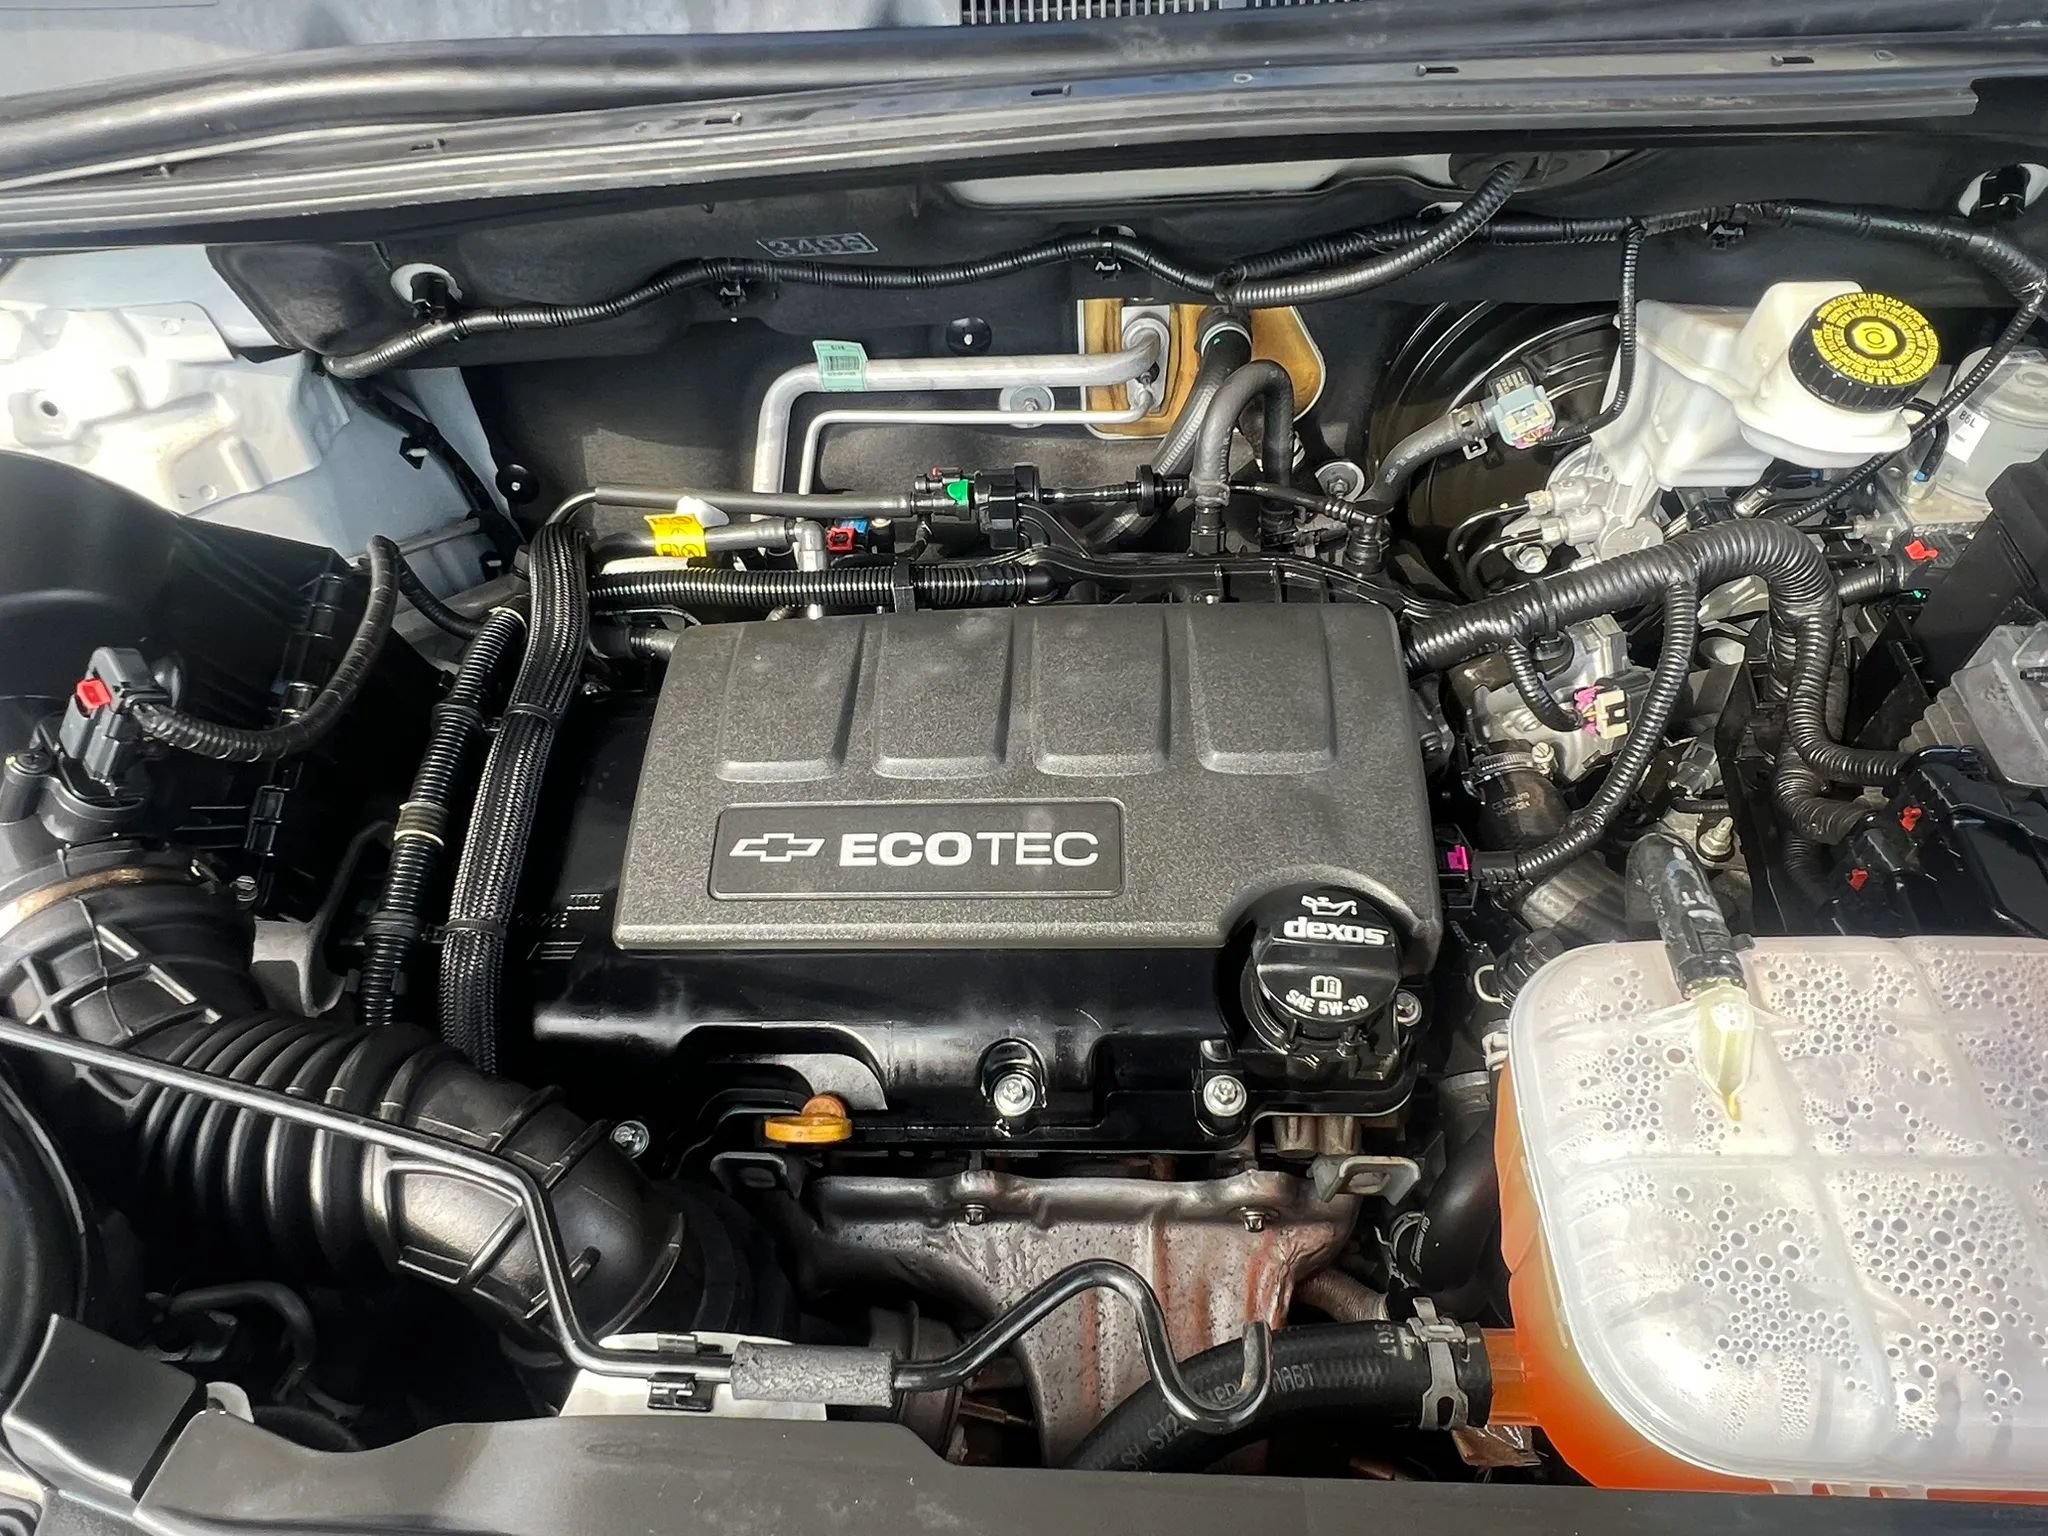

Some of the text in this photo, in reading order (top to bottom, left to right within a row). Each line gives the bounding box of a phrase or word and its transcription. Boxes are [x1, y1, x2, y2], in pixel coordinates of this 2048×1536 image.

[1884, 296, 1904, 308] CAP
[838, 830, 1100, 866] ECOTEC
[1283, 916, 1389, 945] dexos
[1285, 989, 1369, 1016] SAE 5W-30
